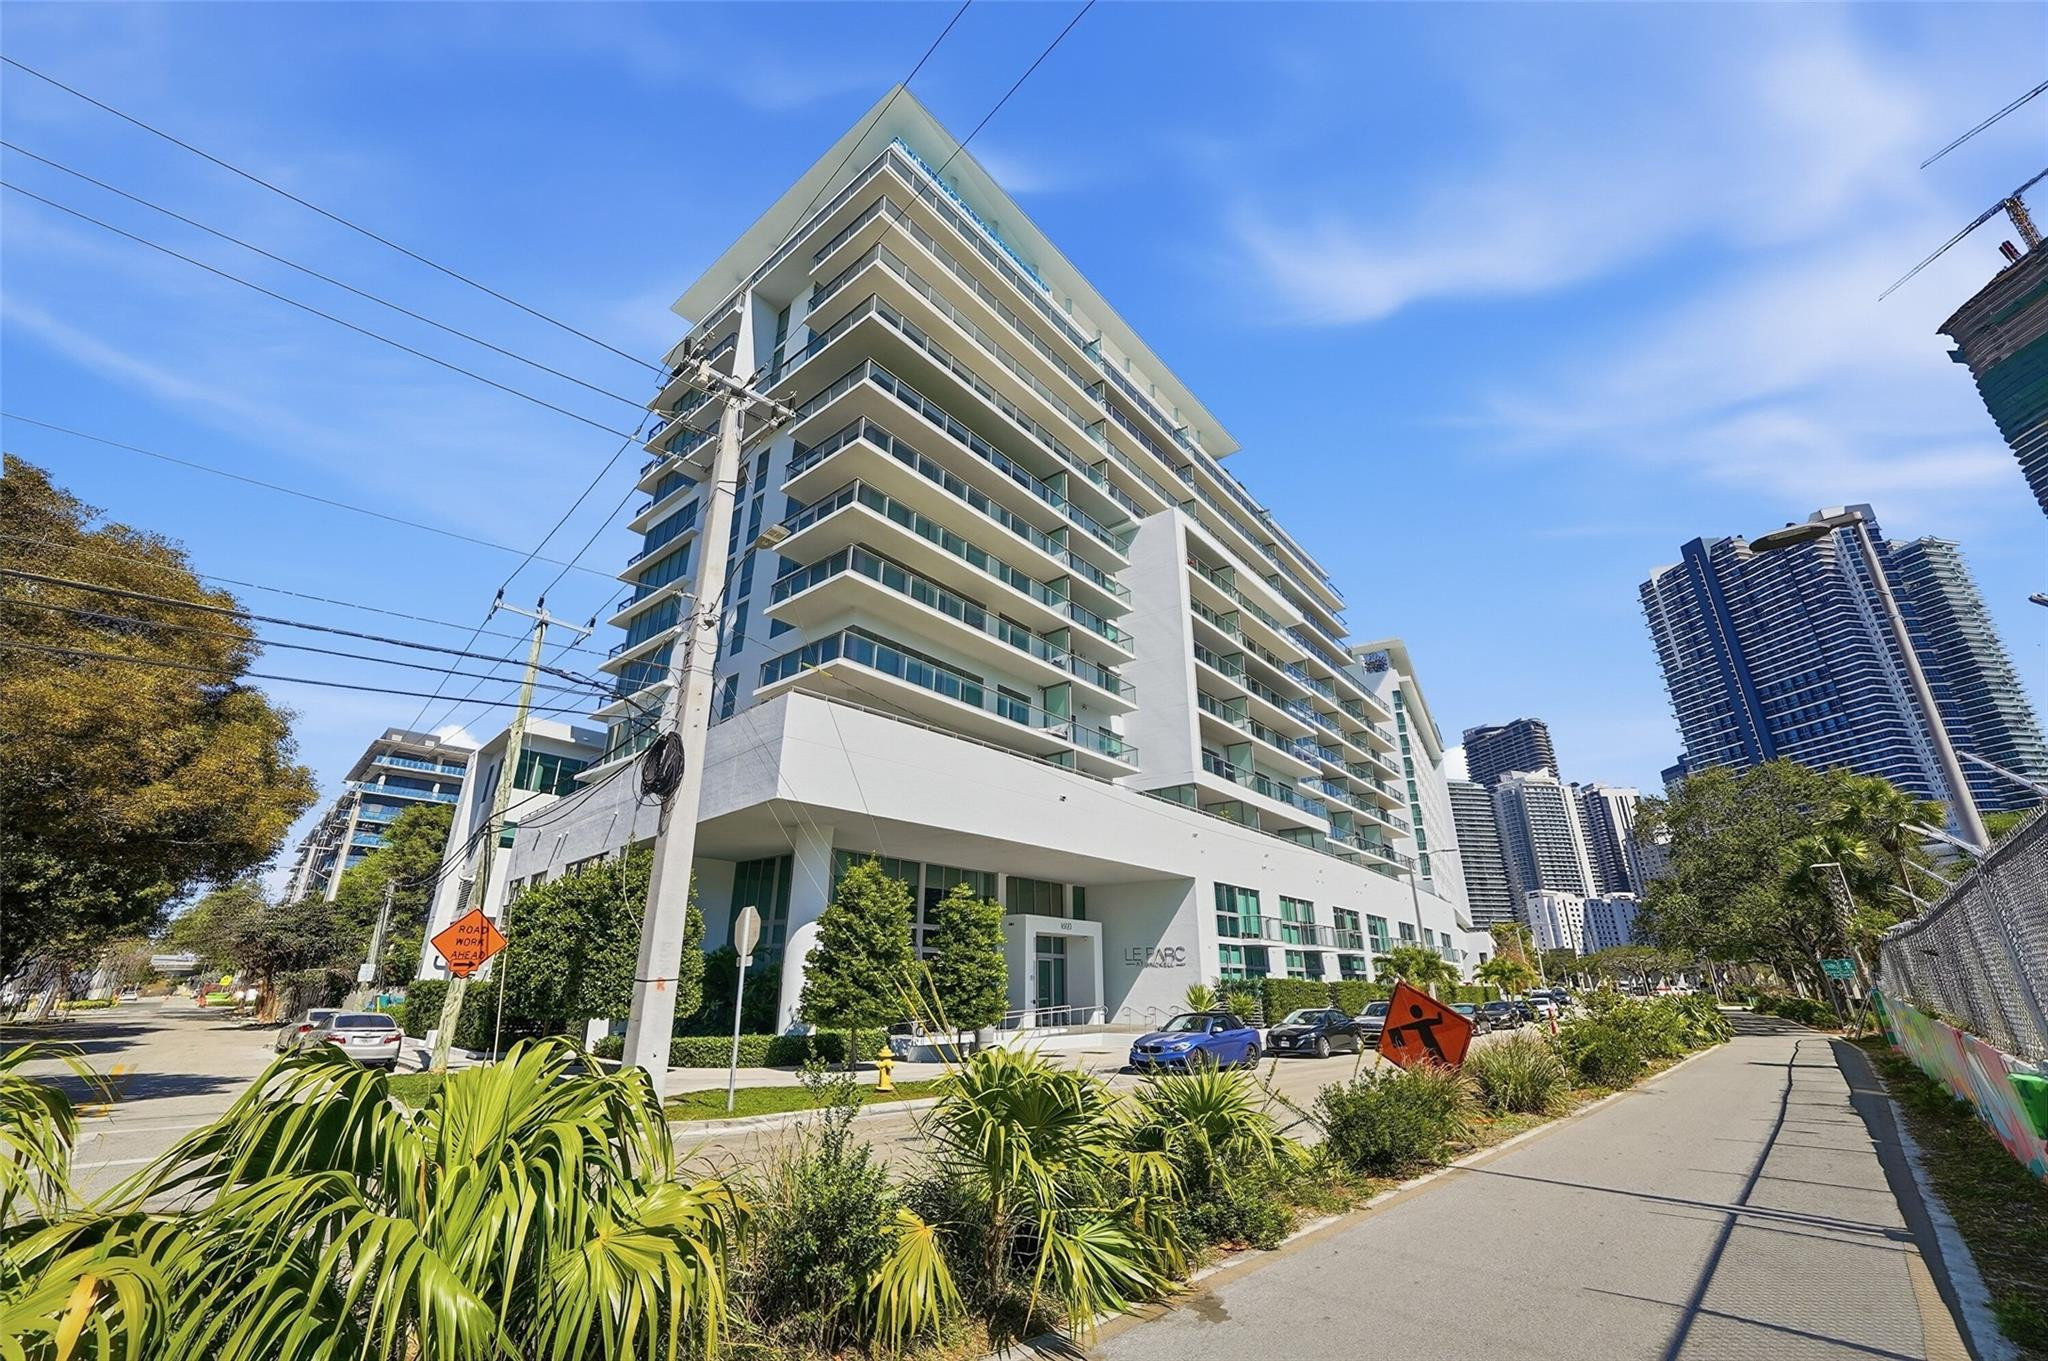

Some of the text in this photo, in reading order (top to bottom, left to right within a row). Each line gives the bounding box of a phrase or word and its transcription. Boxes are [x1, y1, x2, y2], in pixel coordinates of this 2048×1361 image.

[458, 925, 490, 935] ROAD
[455, 938, 485, 947] WORK
[450, 951, 487, 960] AHEAD
[1124, 945, 1186, 963] LE PARC
